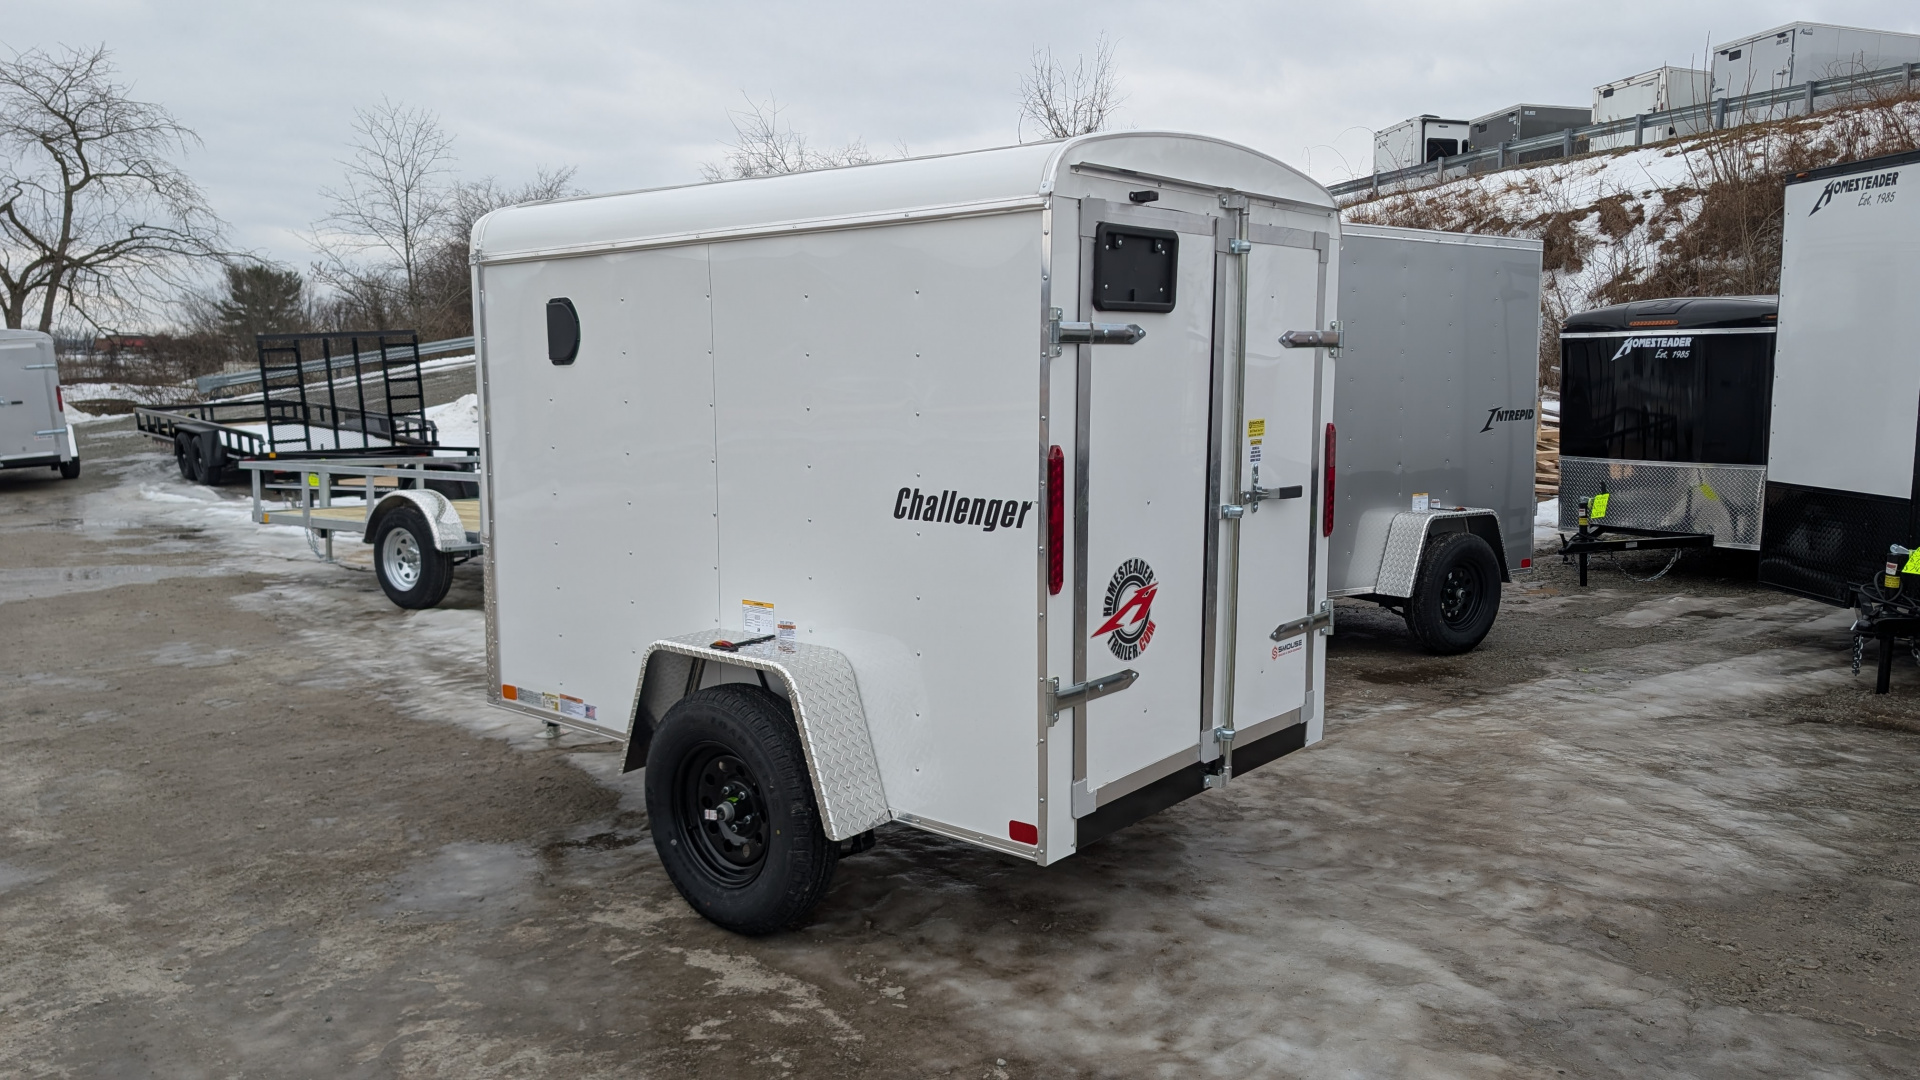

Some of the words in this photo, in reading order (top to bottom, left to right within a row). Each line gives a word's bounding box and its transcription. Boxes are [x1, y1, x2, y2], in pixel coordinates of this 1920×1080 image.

[1808, 171, 1899, 217] HOMESTEADER
[1876, 191, 1896, 204] 1985
[1611, 337, 1692, 361] HOMESTEADER
[1672, 350, 1690, 359] 1985
[1479, 406, 1535, 433] INTREPID
[893, 487, 1033, 532] Challenger
[1103, 558, 1154, 617] HOMESTEADER
[1278, 639, 1303, 653] SMOUSE
